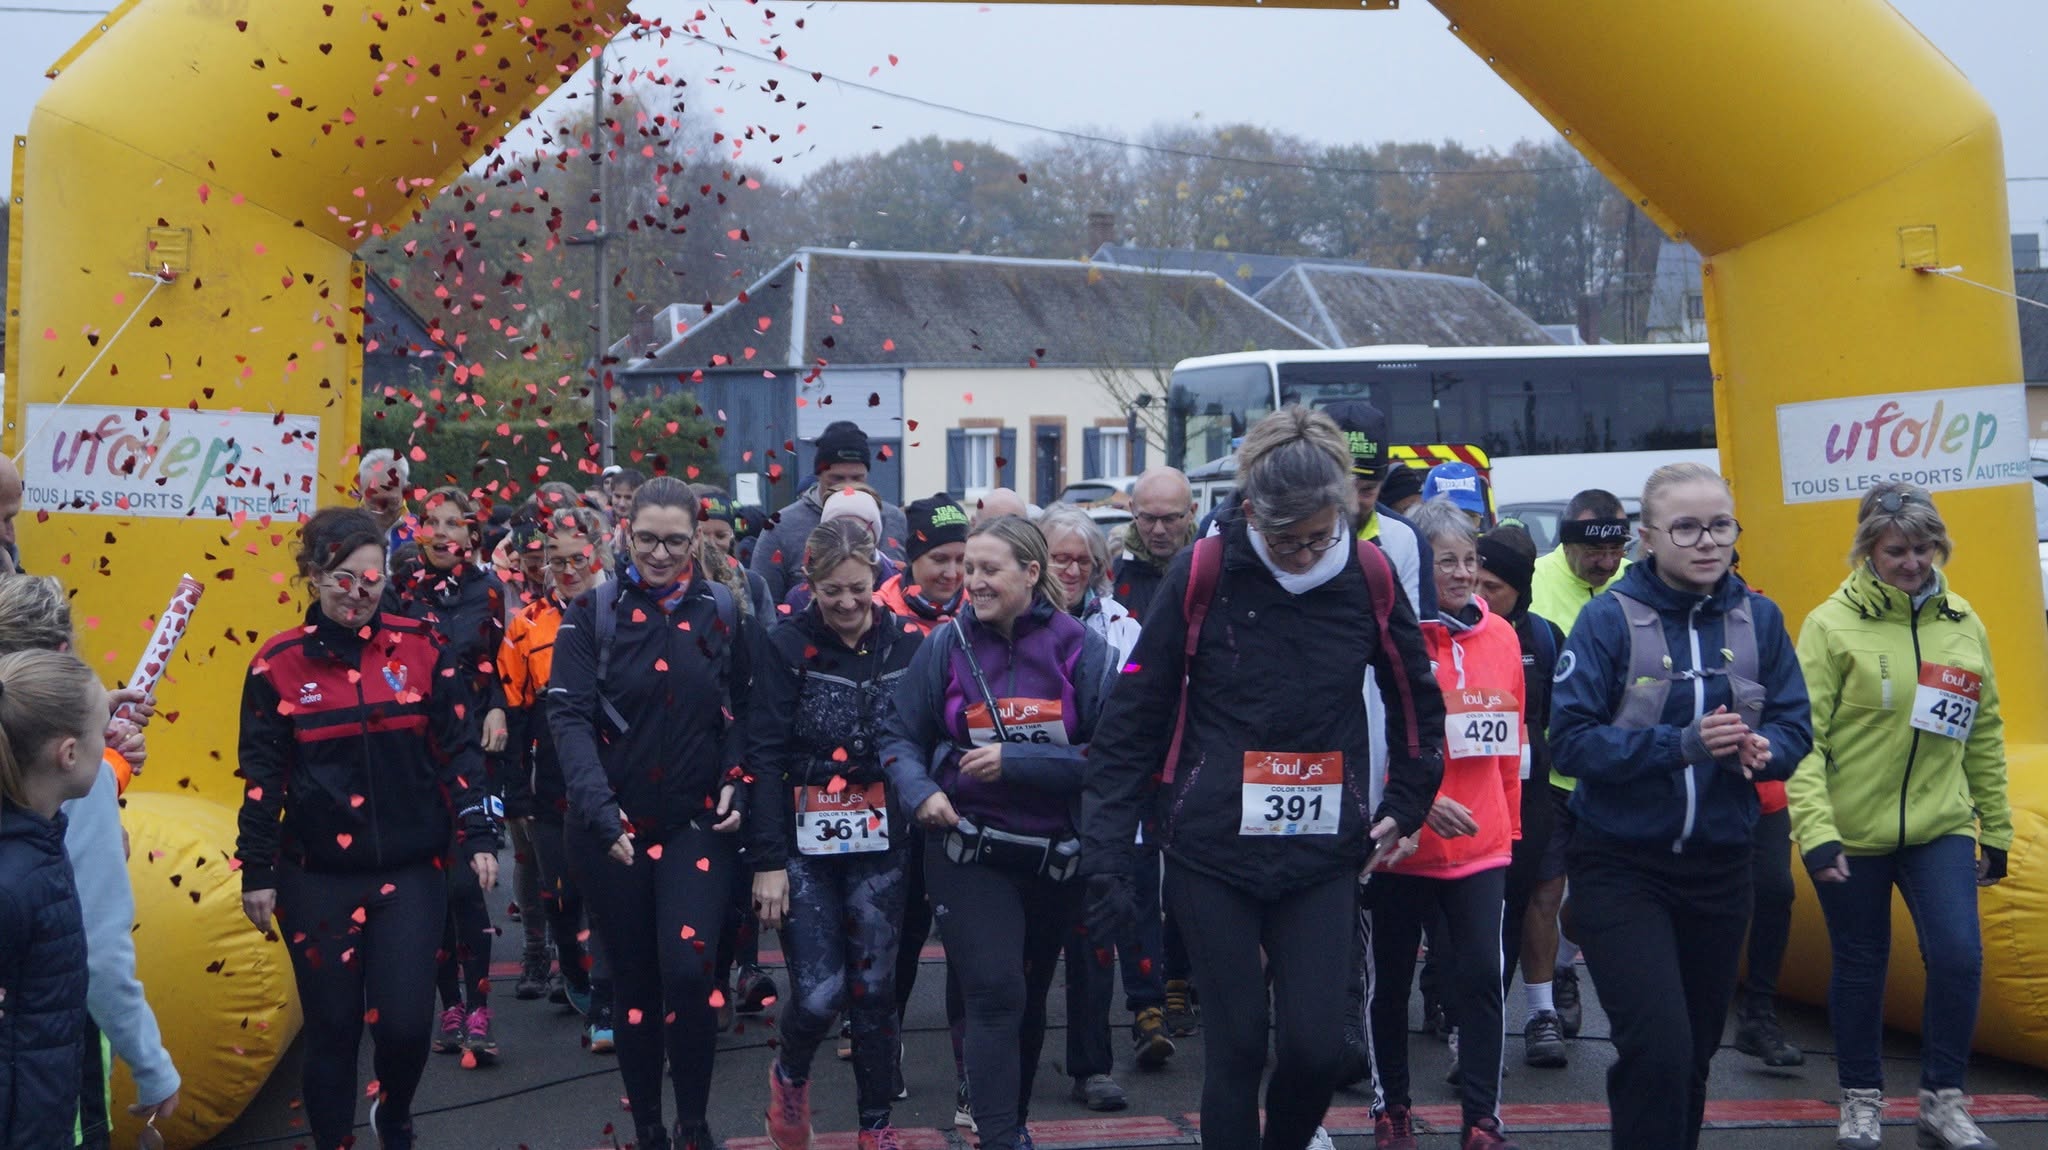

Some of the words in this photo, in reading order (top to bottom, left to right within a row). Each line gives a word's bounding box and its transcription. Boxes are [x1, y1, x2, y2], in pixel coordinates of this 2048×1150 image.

[1826, 399, 1997, 480] ufolep
[52, 413, 242, 507] ufolep
[1791, 478, 1839, 496] TOUS
[1845, 474, 1880, 491] LES
[1889, 467, 1963, 485] SPORTS
[27, 487, 58, 504] TOUS
[64, 489, 95, 505] LES
[101, 490, 183, 509] SPORTS
[1585, 525, 1600, 536] LES
[1930, 698, 1972, 729] 422
[989, 729, 1051, 744] 96
[1464, 720, 1508, 742] 420
[1264, 794, 1322, 821] 391
[815, 817, 868, 842] 361
